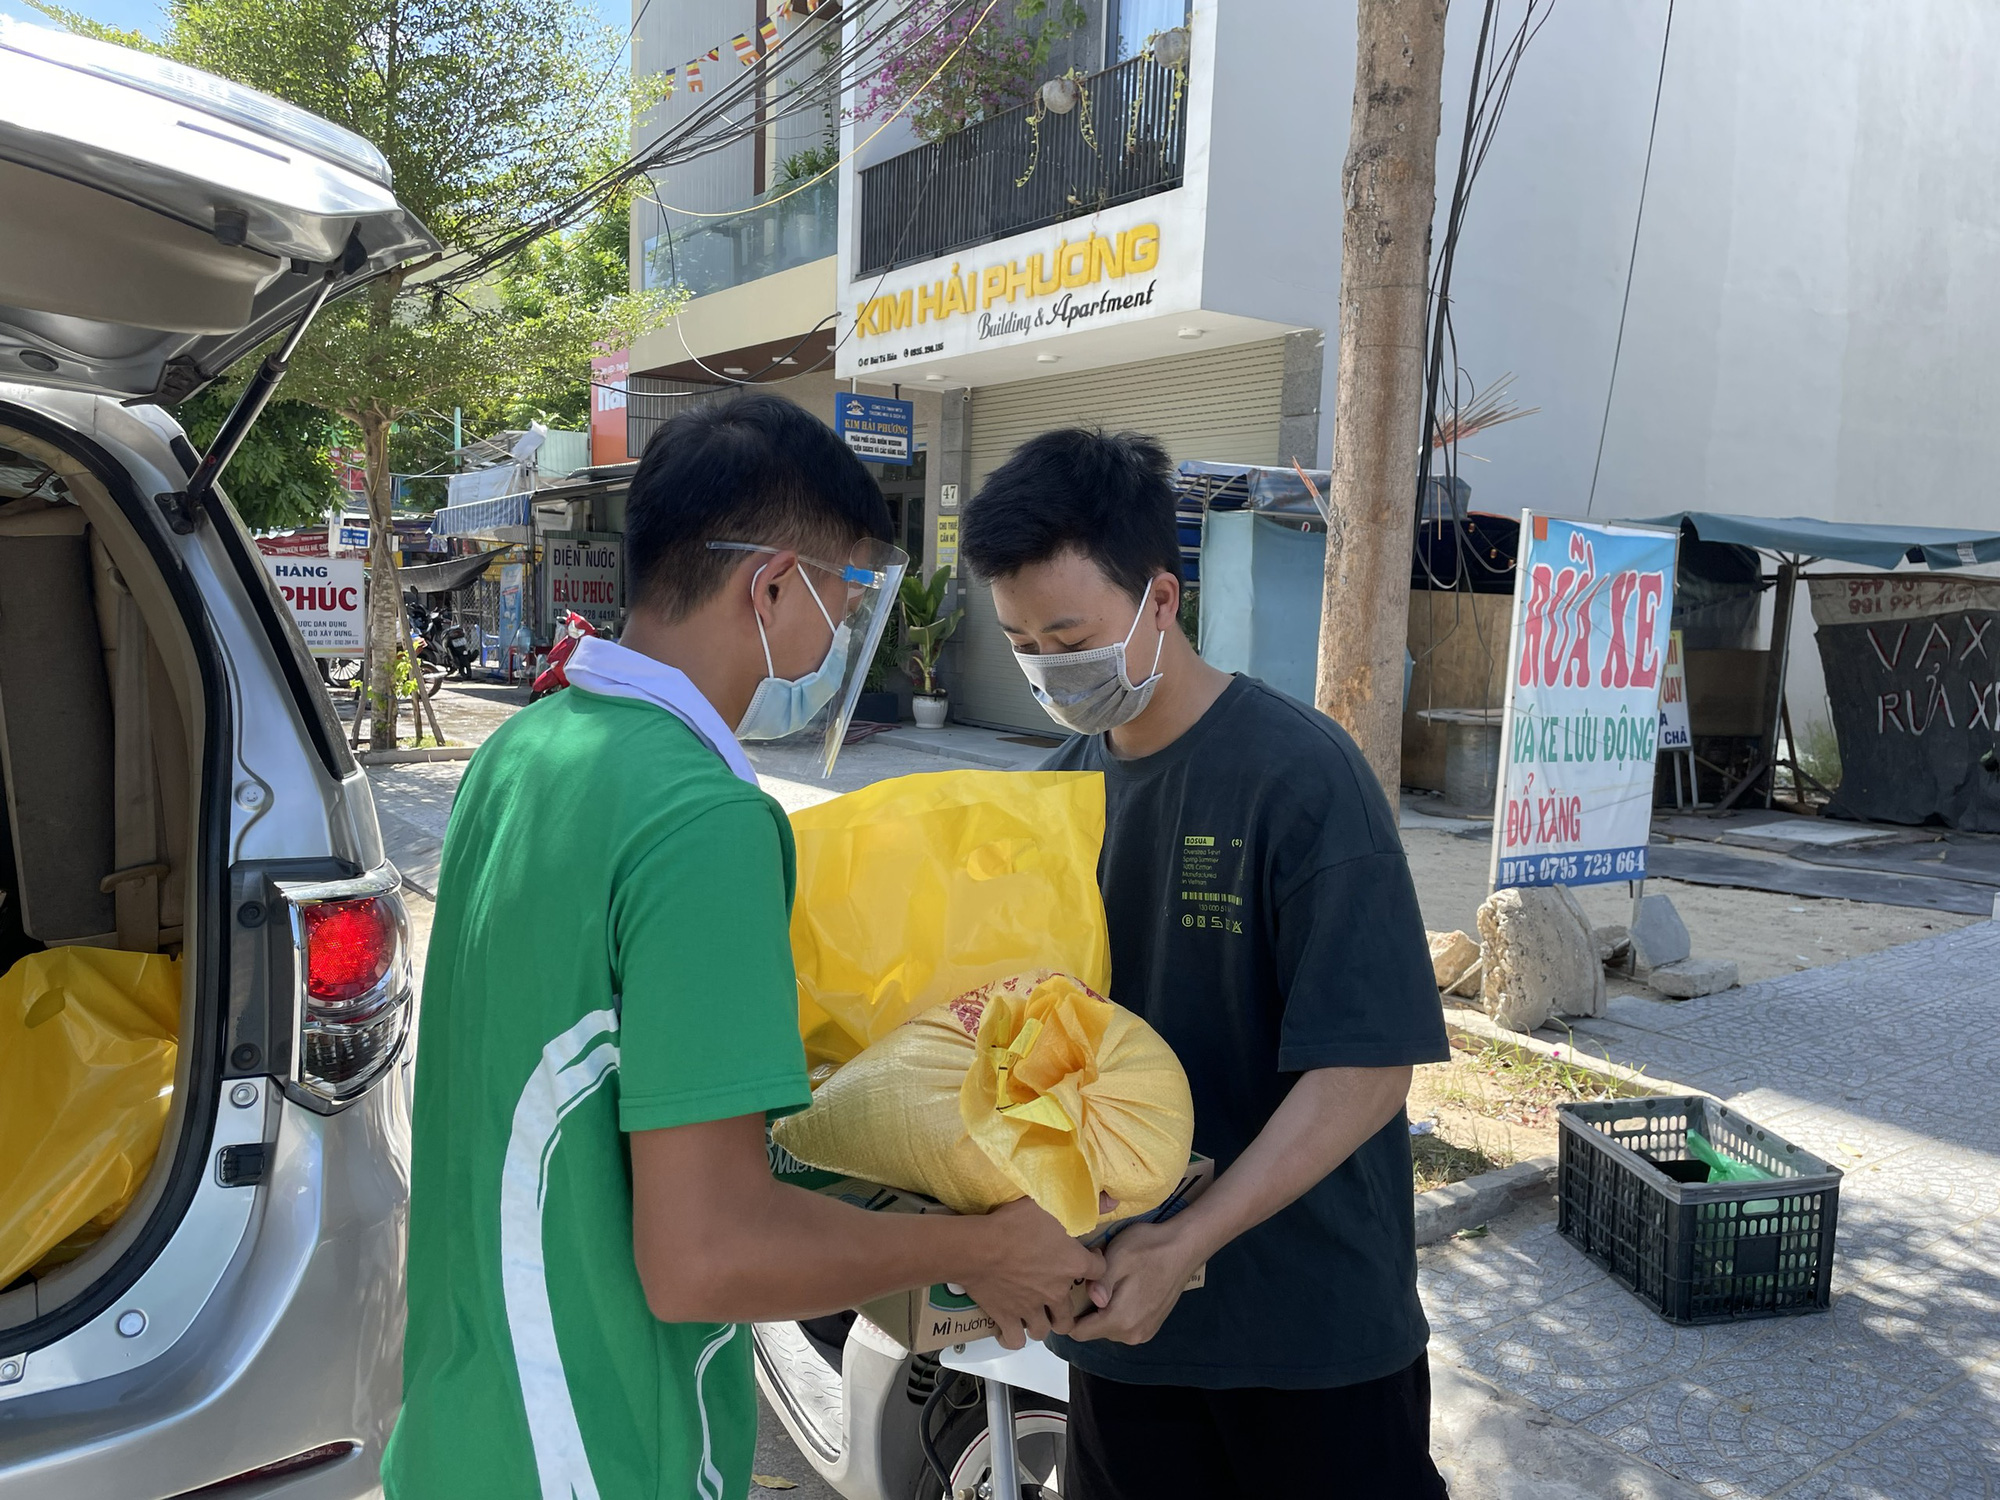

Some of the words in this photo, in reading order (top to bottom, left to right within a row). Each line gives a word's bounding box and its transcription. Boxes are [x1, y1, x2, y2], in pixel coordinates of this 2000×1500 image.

[857, 289, 914, 338] KIM
[917, 262, 977, 324] HẢI
[982, 222, 1161, 309] PHƯƠNG
[978, 311, 1032, 340] Building
[1034, 307, 1045, 328] &
[1045, 279, 1157, 328] Apartment
[845, 419, 860, 430] KIM
[861, 418, 876, 431] HẢI
[877, 422, 908, 435] PHƯƠNG
[942, 486, 956, 499] 47
[275, 563, 328, 577] HÀNG
[554, 545, 580, 570] ĐIỆN
[586, 547, 615, 568] NƯỚC
[280, 581, 358, 611] PHÚC
[553, 573, 580, 608] HẬU
[583, 575, 614, 604] PHÚC
[1601, 571, 1663, 689] XE
[1662, 676, 1682, 703] UAY
[1878, 662, 1955, 736] RỬA
[1513, 703, 1535, 763] VÁ
[1539, 716, 1559, 763] XE
[1563, 708, 1598, 763] LƯU
[1603, 704, 1655, 771] ĐỘNG
[1664, 725, 1688, 745] CHẢ
[1506, 772, 1534, 847] ĐỔ
[1536, 788, 1581, 843] XĂNG
[1540, 855, 1578, 881] 0795
[1584, 853, 1613, 878] 723
[1616, 849, 1646, 874] 664
[932, 1317, 952, 1336] MÌ
